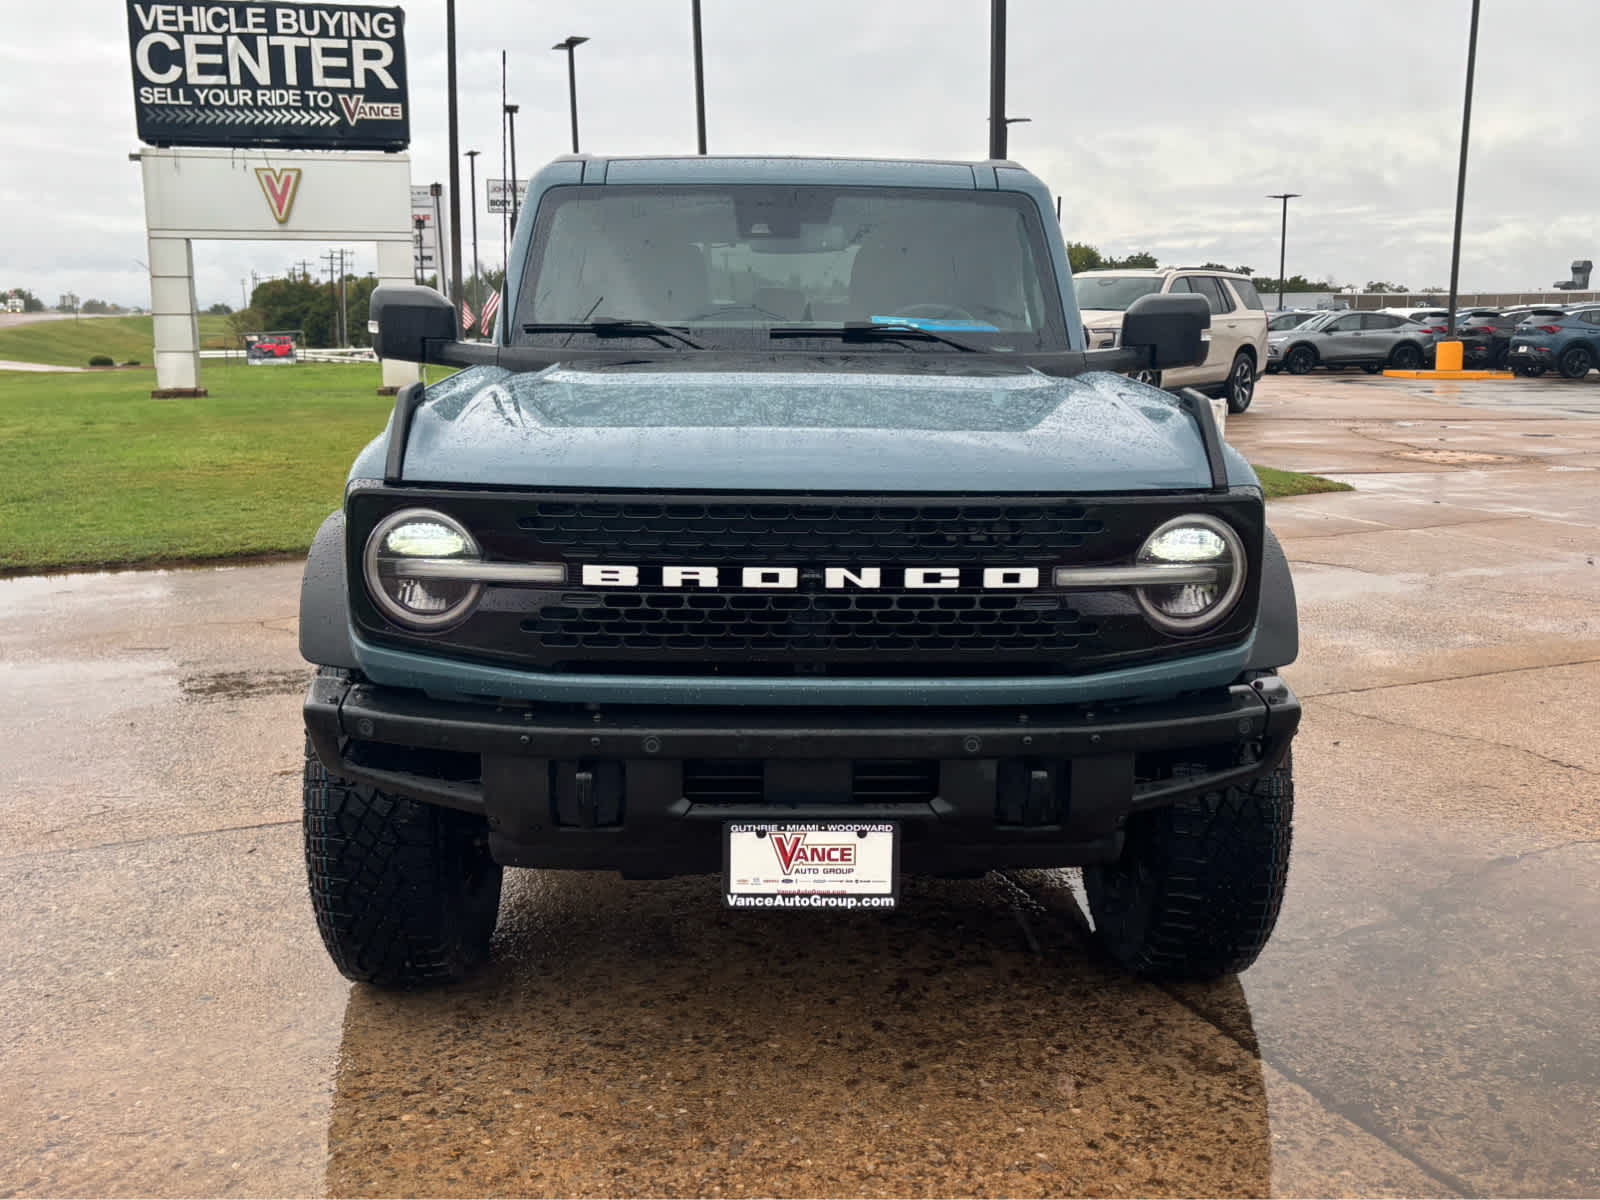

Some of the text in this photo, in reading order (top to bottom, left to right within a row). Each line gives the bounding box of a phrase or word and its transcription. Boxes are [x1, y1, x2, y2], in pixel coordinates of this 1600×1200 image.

[134, 4, 396, 38] VEHICLE BUYING
[136, 32, 399, 89] CENTER
[140, 87, 402, 126] SELL YOUR RIDE TO VANCE
[254, 168, 302, 224] V
[582, 565, 1039, 589] BRONCO
[730, 824, 893, 832] GUTHRIE MIAMI WOODWARD
[770, 834, 855, 874] VANCE
[727, 894, 895, 909] VanceAutoGroup.com
